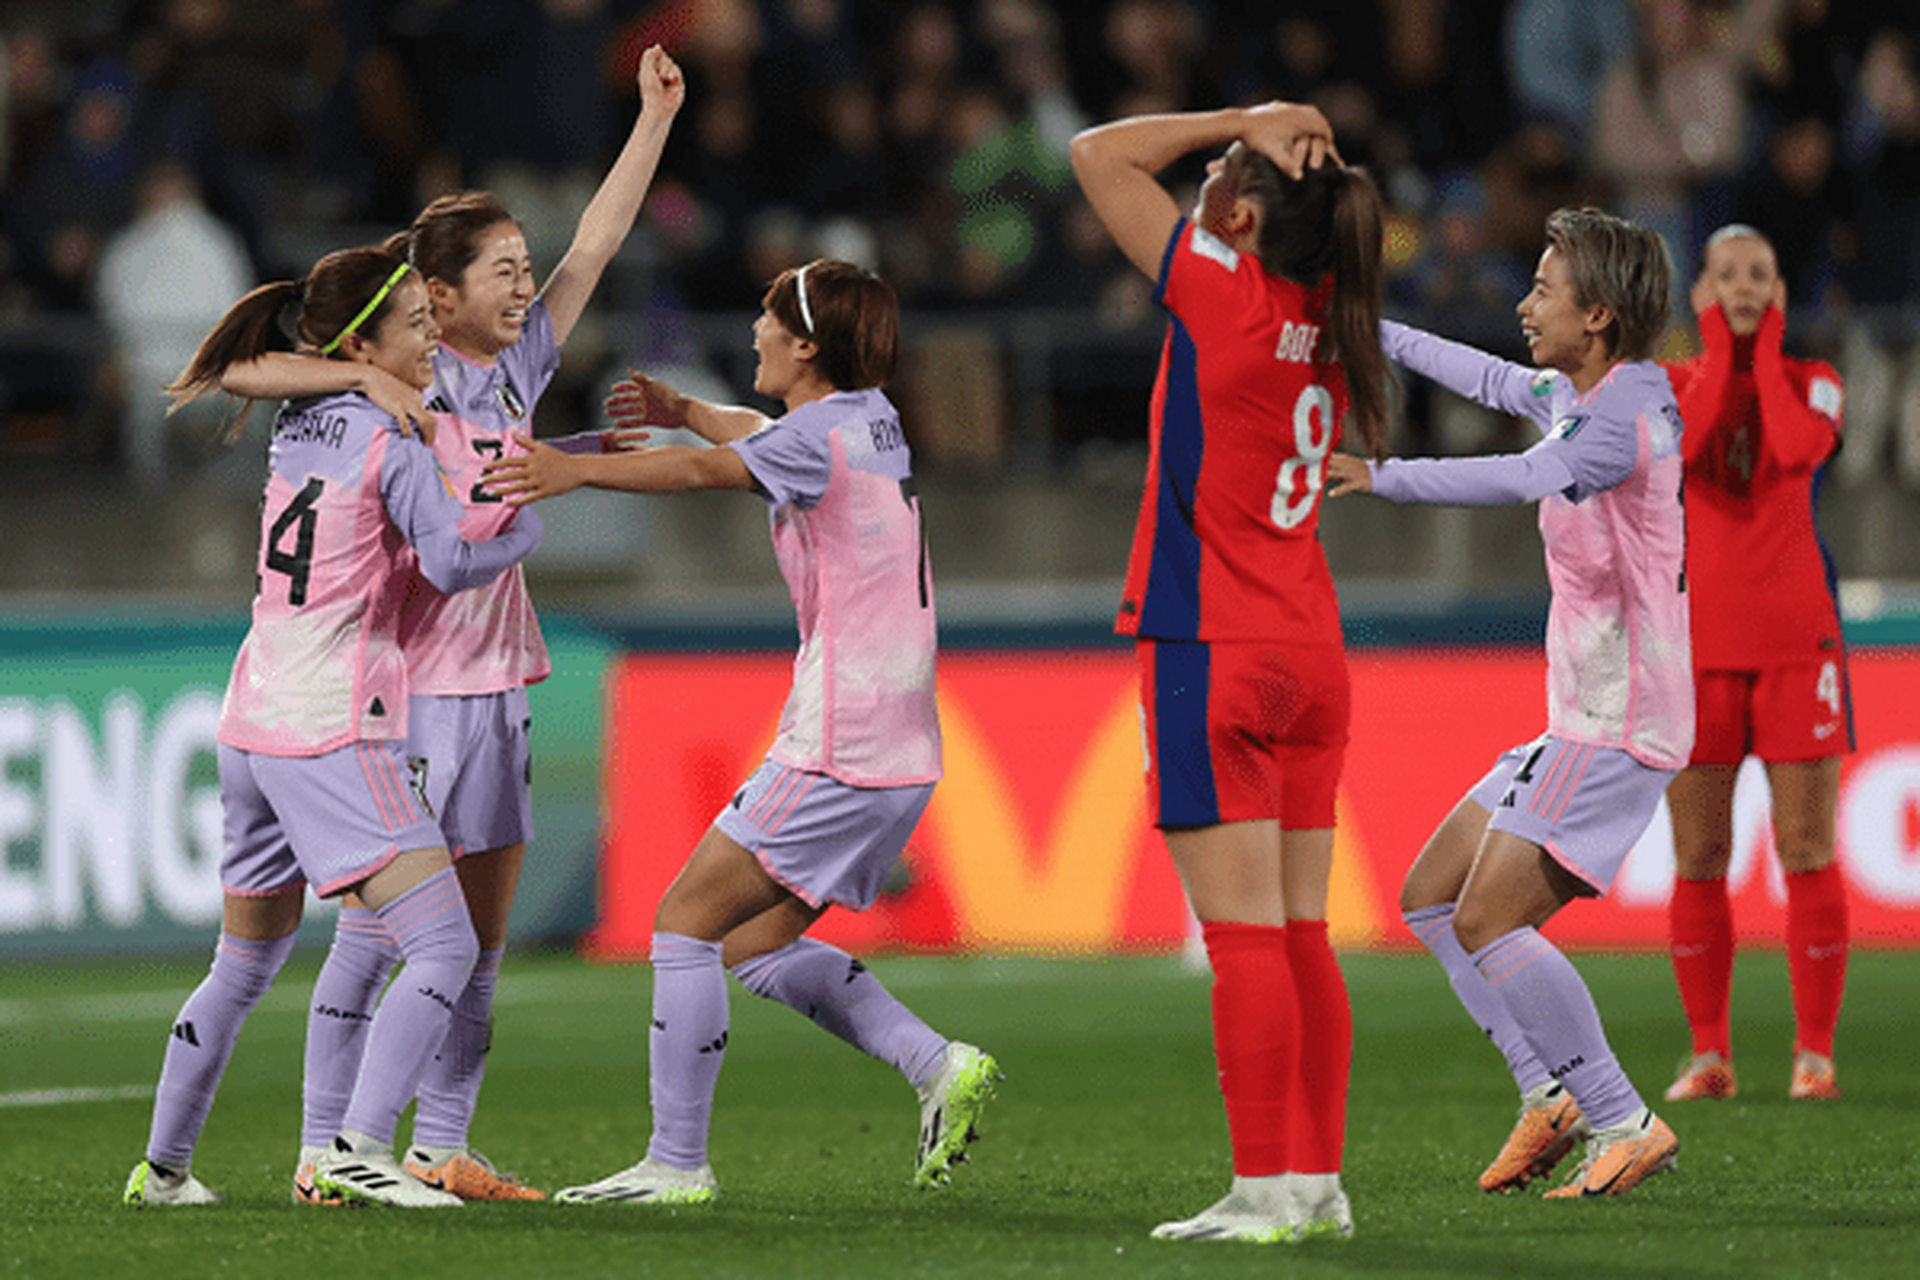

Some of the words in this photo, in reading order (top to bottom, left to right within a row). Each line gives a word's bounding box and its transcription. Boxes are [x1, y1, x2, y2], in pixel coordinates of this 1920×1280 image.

[470, 438, 504, 503] 2
[1269, 383, 1333, 530] 8
[257, 476, 325, 607] 4
[1816, 661, 1840, 715] 4
[0, 688, 224, 926] ENG
